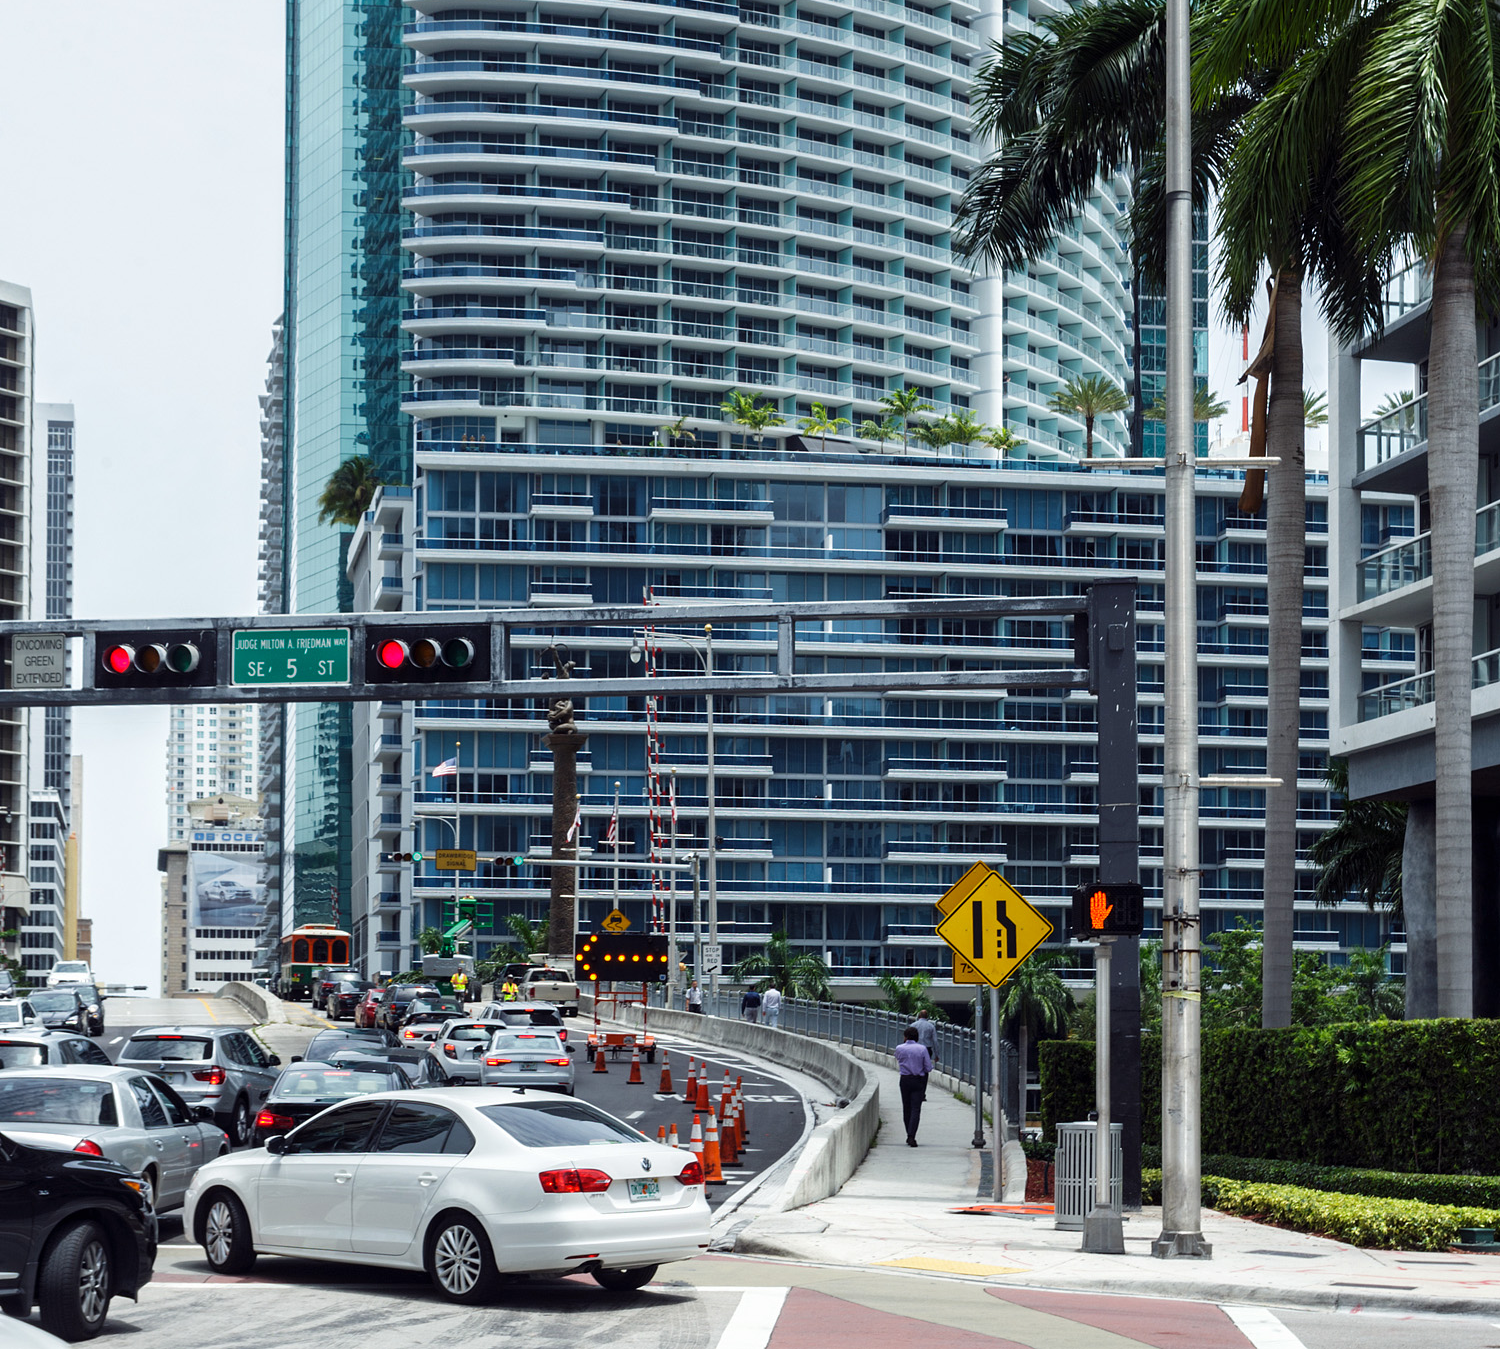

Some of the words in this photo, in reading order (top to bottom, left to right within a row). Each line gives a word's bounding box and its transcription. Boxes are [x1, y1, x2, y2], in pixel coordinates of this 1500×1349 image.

[16, 639, 62, 651] ONCOMING
[235, 639, 258, 650] JUDGE
[260, 638, 285, 649] MILTON
[287, 638, 295, 649] A.
[296, 638, 332, 649] FRIEDMAN
[334, 637, 347, 646] WAY
[24, 655, 54, 667] GREEN
[247, 661, 265, 677] SE
[286, 658, 297, 679] 5
[317, 659, 335, 676] ST
[16, 672, 62, 684] EXTENDED
[438, 852, 474, 860] DRAWBRIDGE
[619, 1001, 633, 1009] 753
